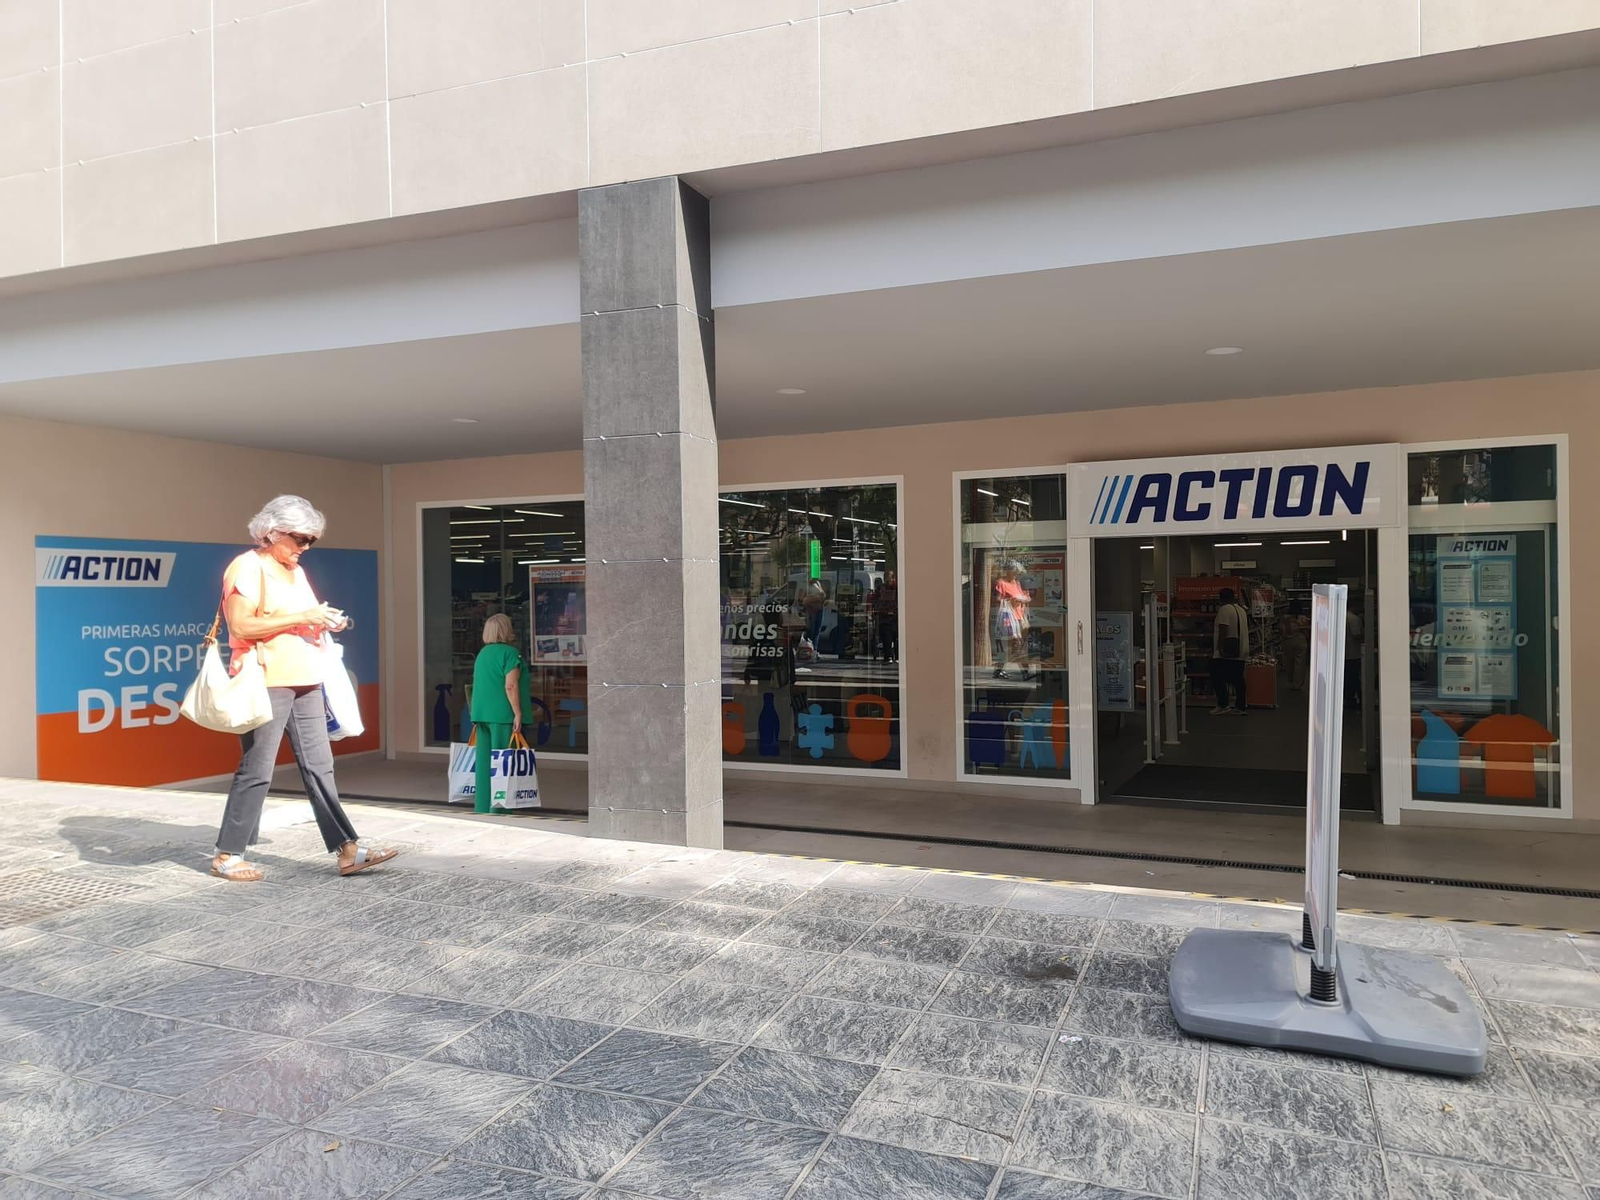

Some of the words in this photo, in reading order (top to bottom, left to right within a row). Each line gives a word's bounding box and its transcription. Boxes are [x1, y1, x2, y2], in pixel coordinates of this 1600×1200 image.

[1125, 461, 1371, 524] ACTION
[1452, 539, 1510, 553] ACTION
[59, 555, 162, 582] ACTION
[746, 601, 789, 615] precios
[81, 624, 161, 640] PRIMERAS
[724, 617, 778, 640] ndes
[77, 682, 180, 734] DES
